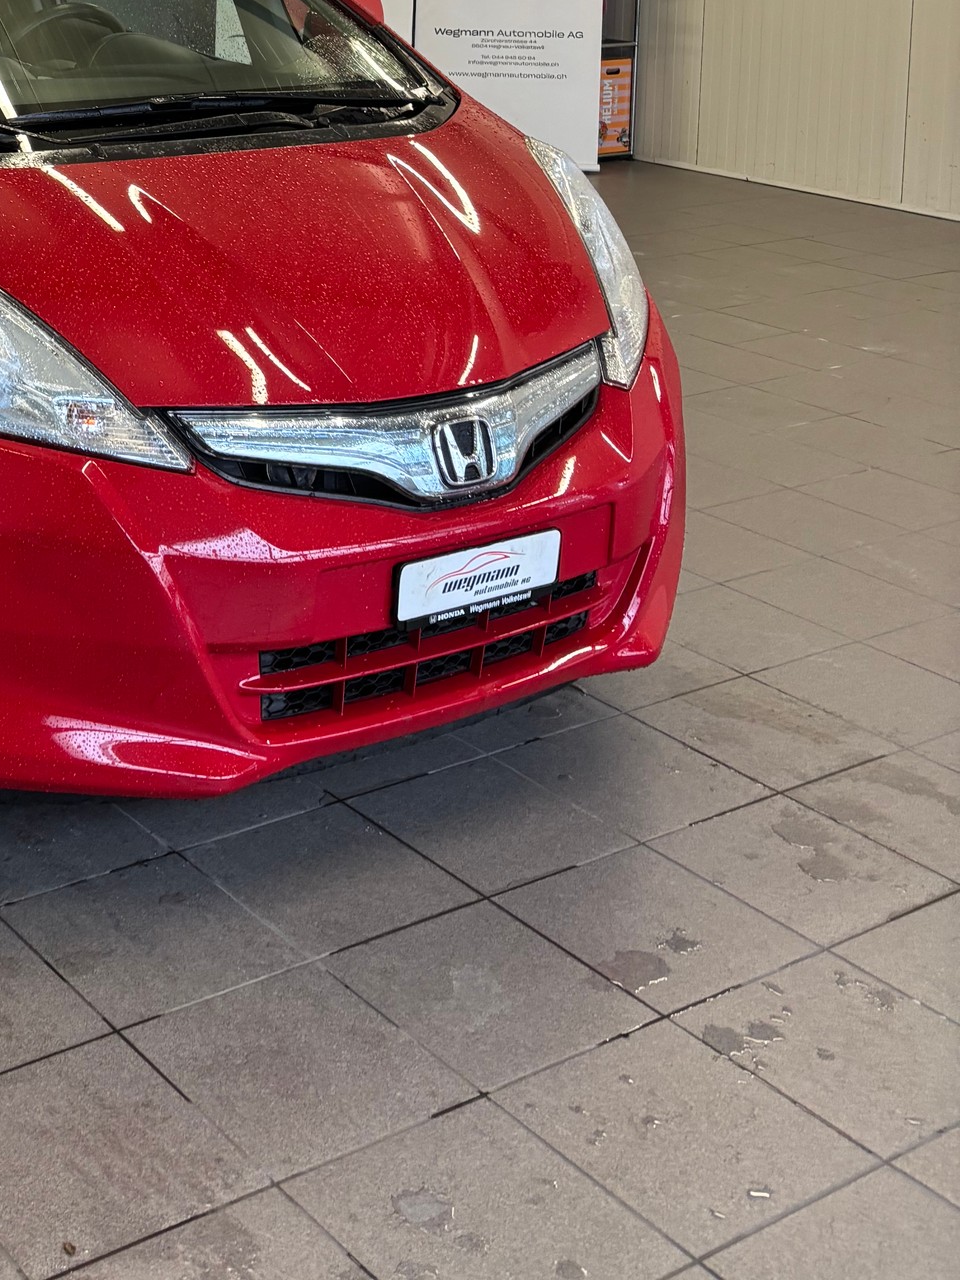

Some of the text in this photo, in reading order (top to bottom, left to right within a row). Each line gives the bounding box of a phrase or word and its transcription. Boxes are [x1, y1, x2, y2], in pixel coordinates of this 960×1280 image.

[434, 27, 584, 39] Wegmann Automobile AG
[448, 71, 568, 80] www.wegmannautomobile.ch
[441, 564, 521, 594] wegmann
[437, 590, 532, 622] HONDA Wegmann Volketswil
